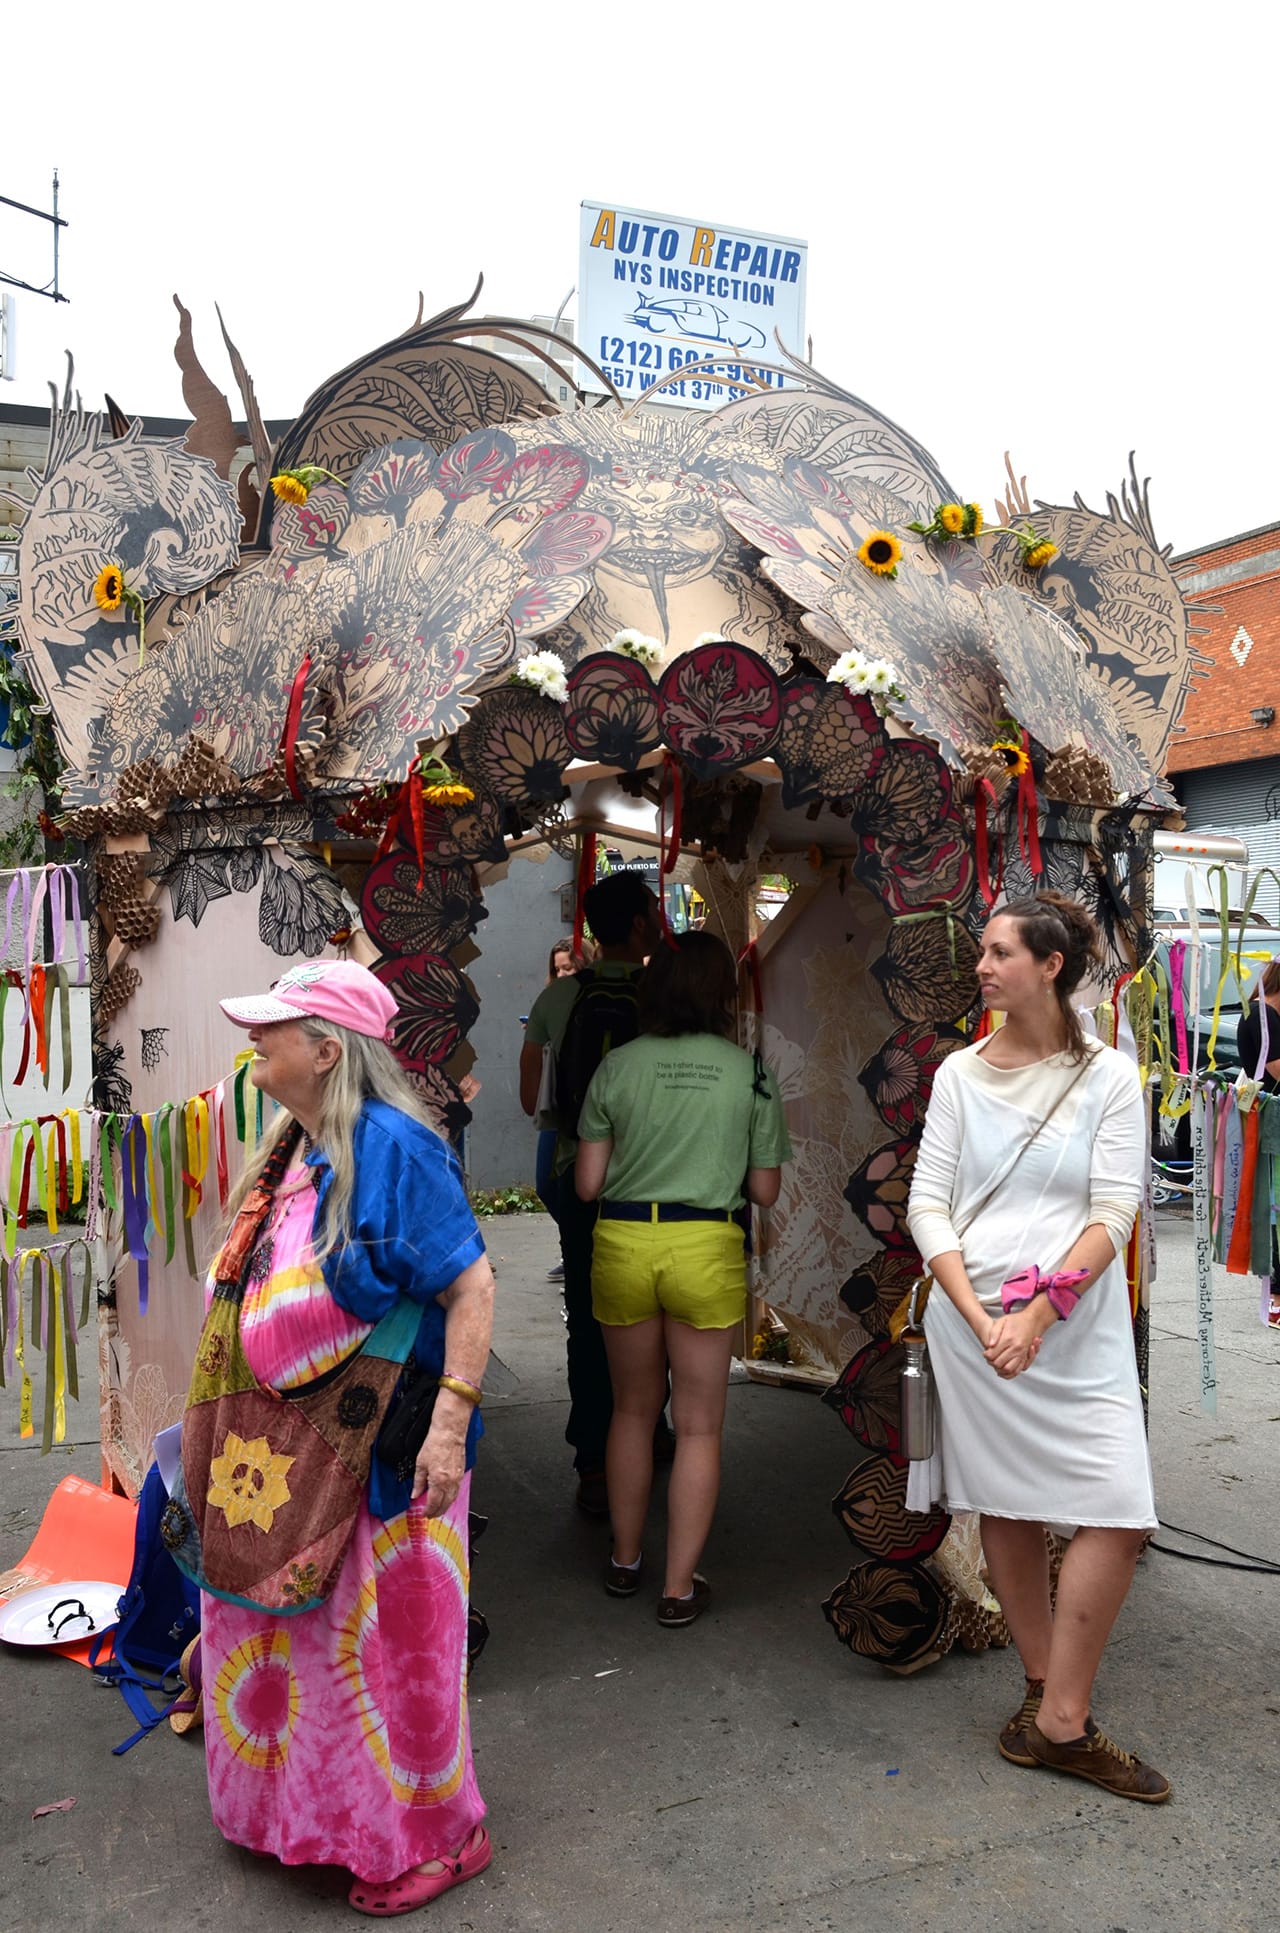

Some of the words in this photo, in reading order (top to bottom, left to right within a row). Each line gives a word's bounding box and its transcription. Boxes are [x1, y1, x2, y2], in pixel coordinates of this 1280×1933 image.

[590, 209, 679, 261] AUTO
[689, 227, 801, 283] REPAIR
[614, 258, 652, 285] NYS
[659, 266, 775, 306] INSPECTION
[601, 335, 662, 369] (212)
[656, 1062, 672, 1070] This
[694, 1063, 714, 1071] used
[656, 1071, 666, 1079] be
[674, 1071, 697, 1079] plastic
